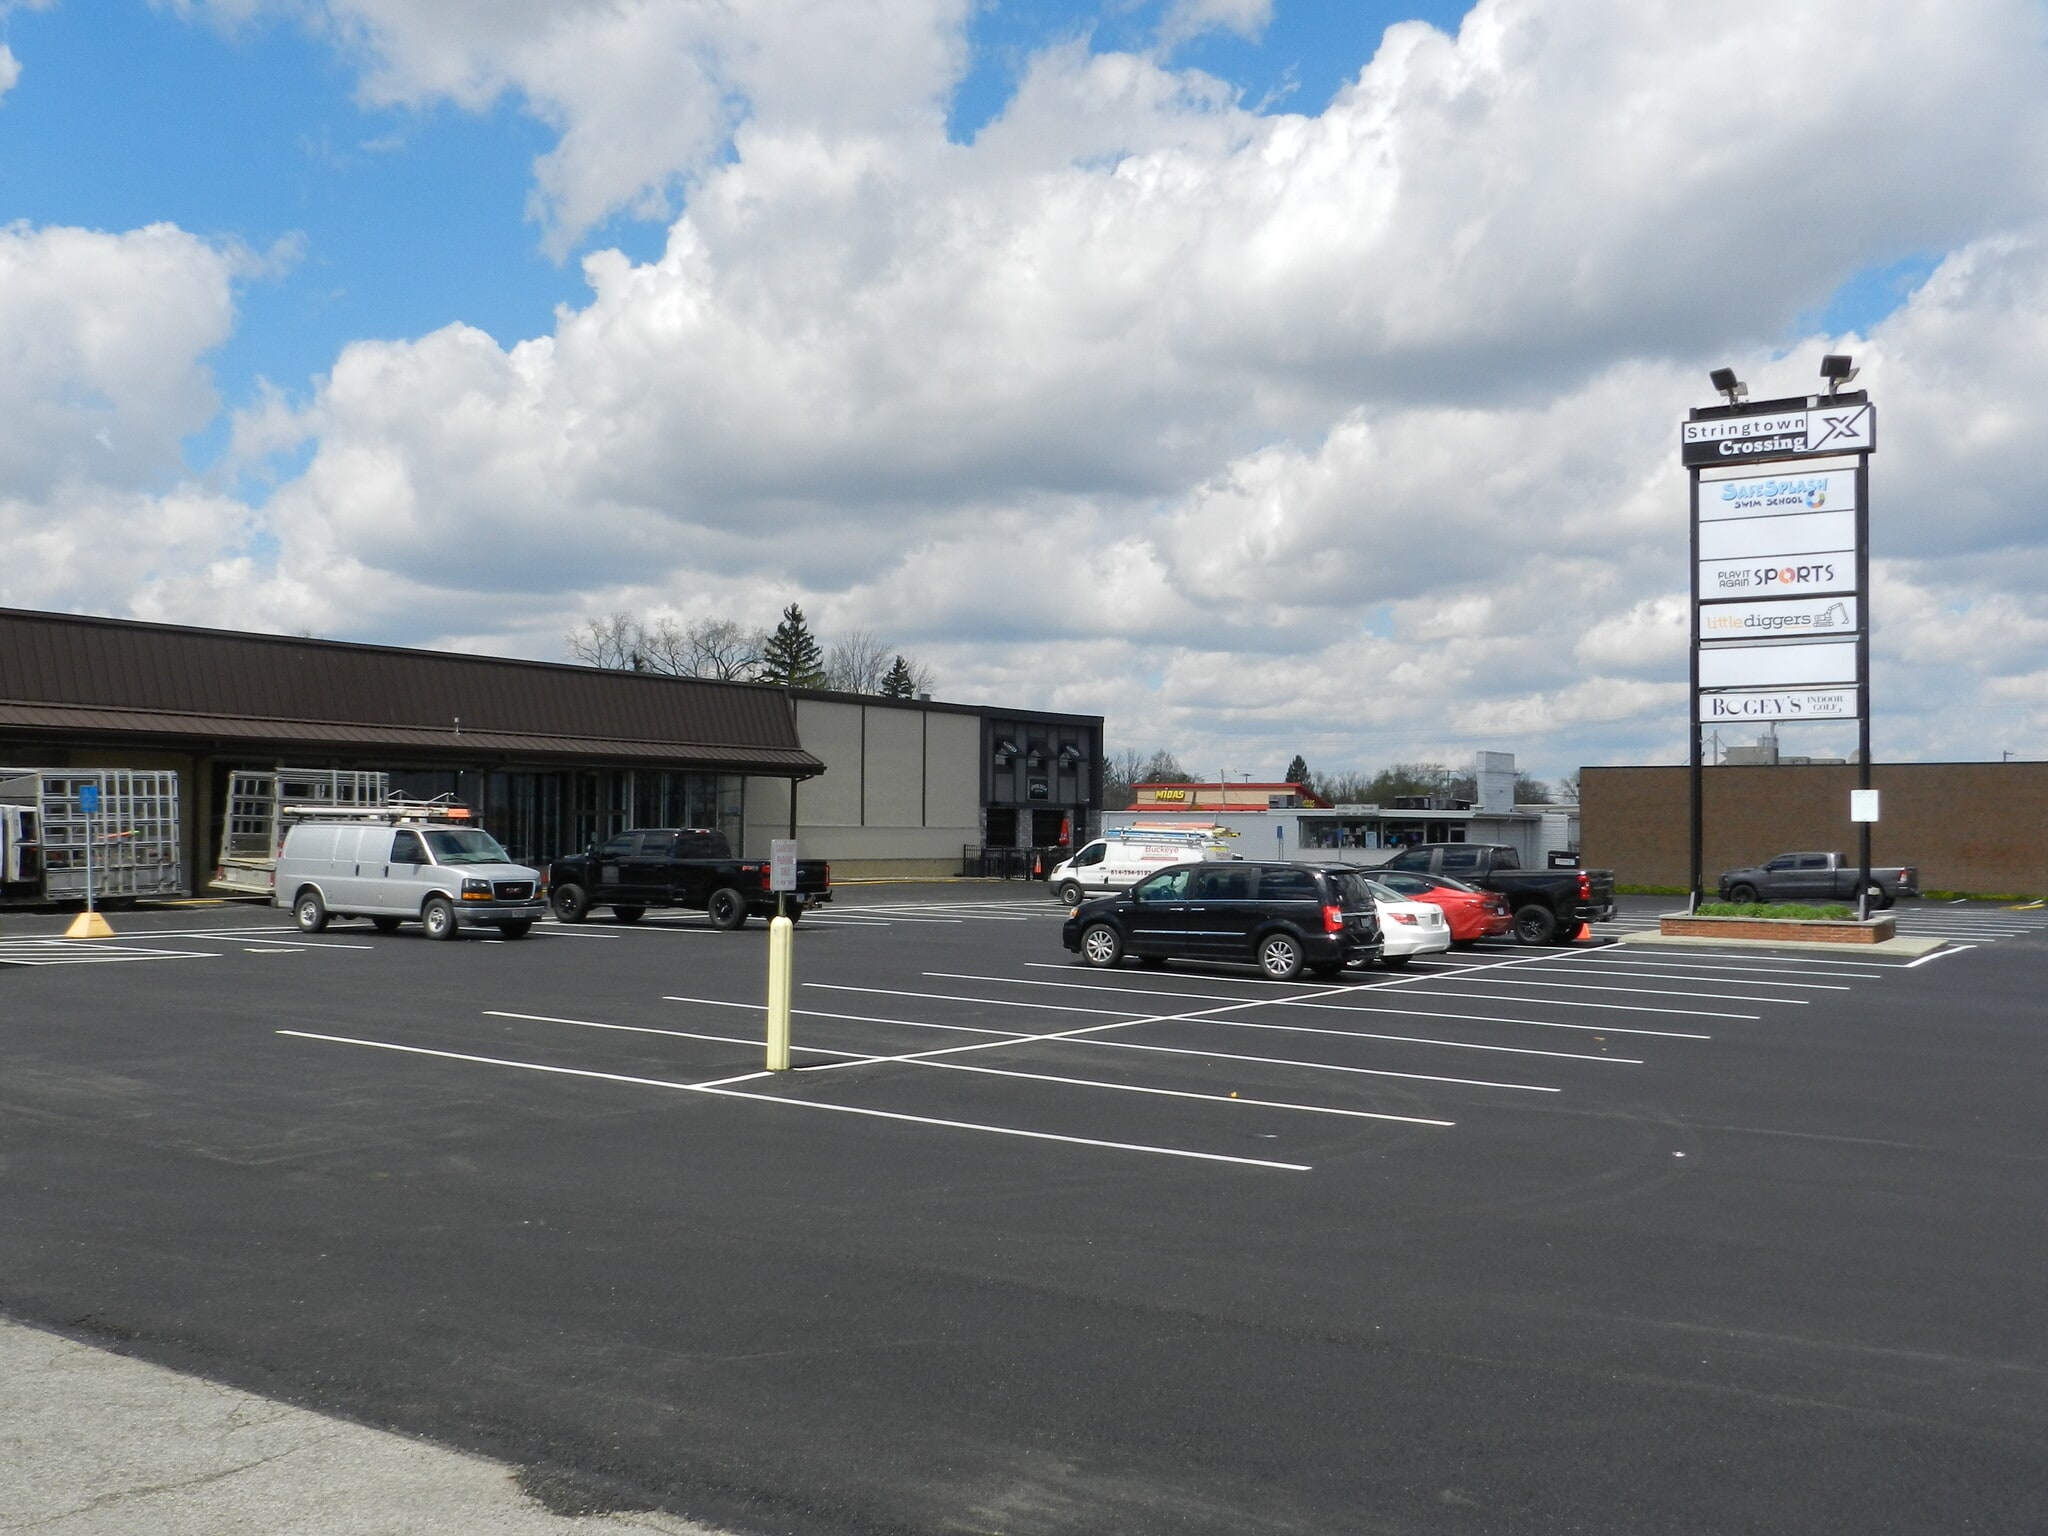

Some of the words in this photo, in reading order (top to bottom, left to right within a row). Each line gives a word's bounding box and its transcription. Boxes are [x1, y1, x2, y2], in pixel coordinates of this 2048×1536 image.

[1687, 417, 1805, 439] Stringtown
[1718, 434, 1806, 456] Crossing
[1734, 500, 1762, 509] SWIM
[1766, 497, 1803, 507] SCHOOL
[1717, 571, 1741, 580] PLAY
[1753, 564, 1834, 586] SPORTS
[1719, 578, 1750, 588] AGAIN
[1807, 695, 1843, 704] INDOOR
[1712, 695, 1802, 716] BOGEY'S
[1155, 790, 1185, 799] MIDAS
[1145, 845, 1179, 854] Buckeye
